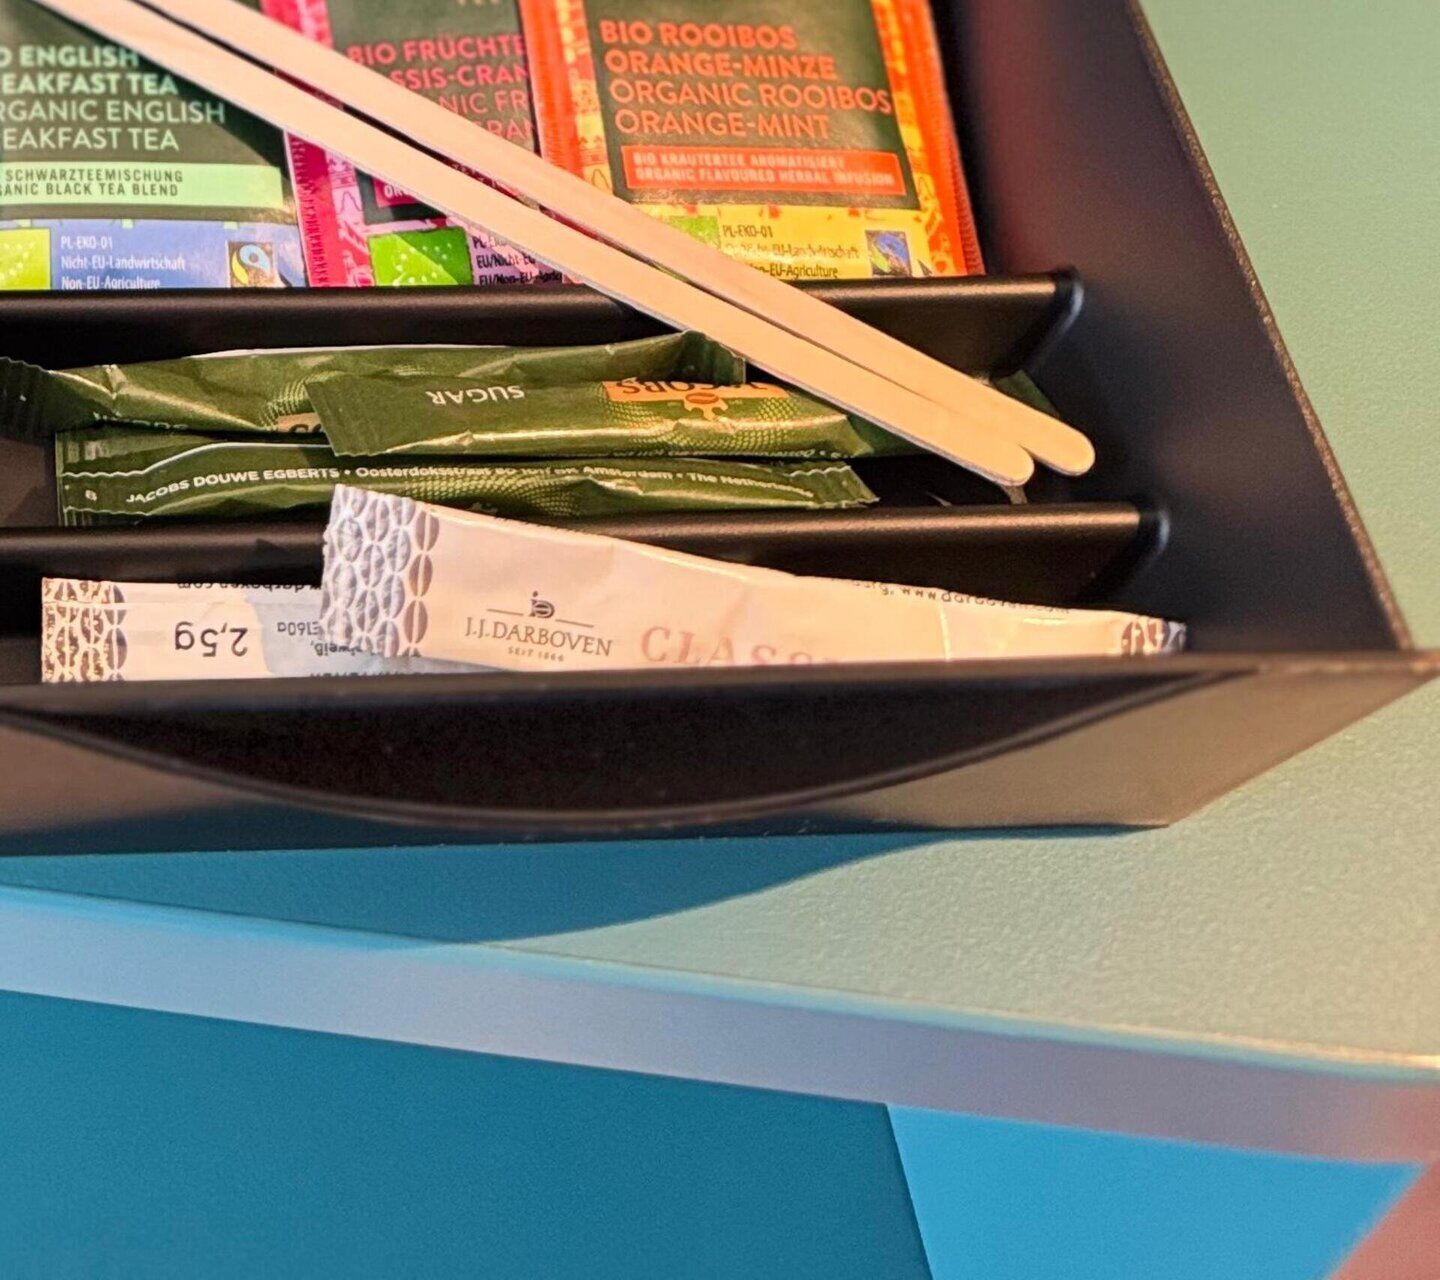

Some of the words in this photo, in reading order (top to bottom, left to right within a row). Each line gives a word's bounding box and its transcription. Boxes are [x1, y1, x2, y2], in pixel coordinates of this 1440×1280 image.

[600, 20, 652, 45] BIO
[659, 21, 797, 50] ROOIBOS
[20, 45, 139, 68] ENGLISH
[346, 43, 396, 65] BIO
[605, 49, 838, 80] ORANGE-MINZE
[126, 72, 179, 96] TEA
[610, 79, 753, 106] ORGANIC
[760, 84, 892, 114] ROOIBOS
[107, 100, 225, 124] ENGLISH
[615, 109, 830, 139] ORANGE-MINT
[128, 128, 179, 151] TEA
[632, 152, 656, 166] BIO
[5, 169, 183, 183] SCHWARZTEEMISCHUNG
[46, 183, 92, 196] BLACK
[99, 183, 126, 196] TEA
[133, 184, 178, 197] BLEND
[61, 237, 113, 249] PL-EKO-01
[722, 225, 773, 238] PL-EKO-01
[426, 385, 525, 406] SUGAR
[126, 480, 189, 503] JACOBS
[194, 471, 259, 487] DOUWE
[264, 468, 339, 480] EGBERTS
[584, 466, 672, 480] Amsterdam
[689, 472, 717, 484] The
